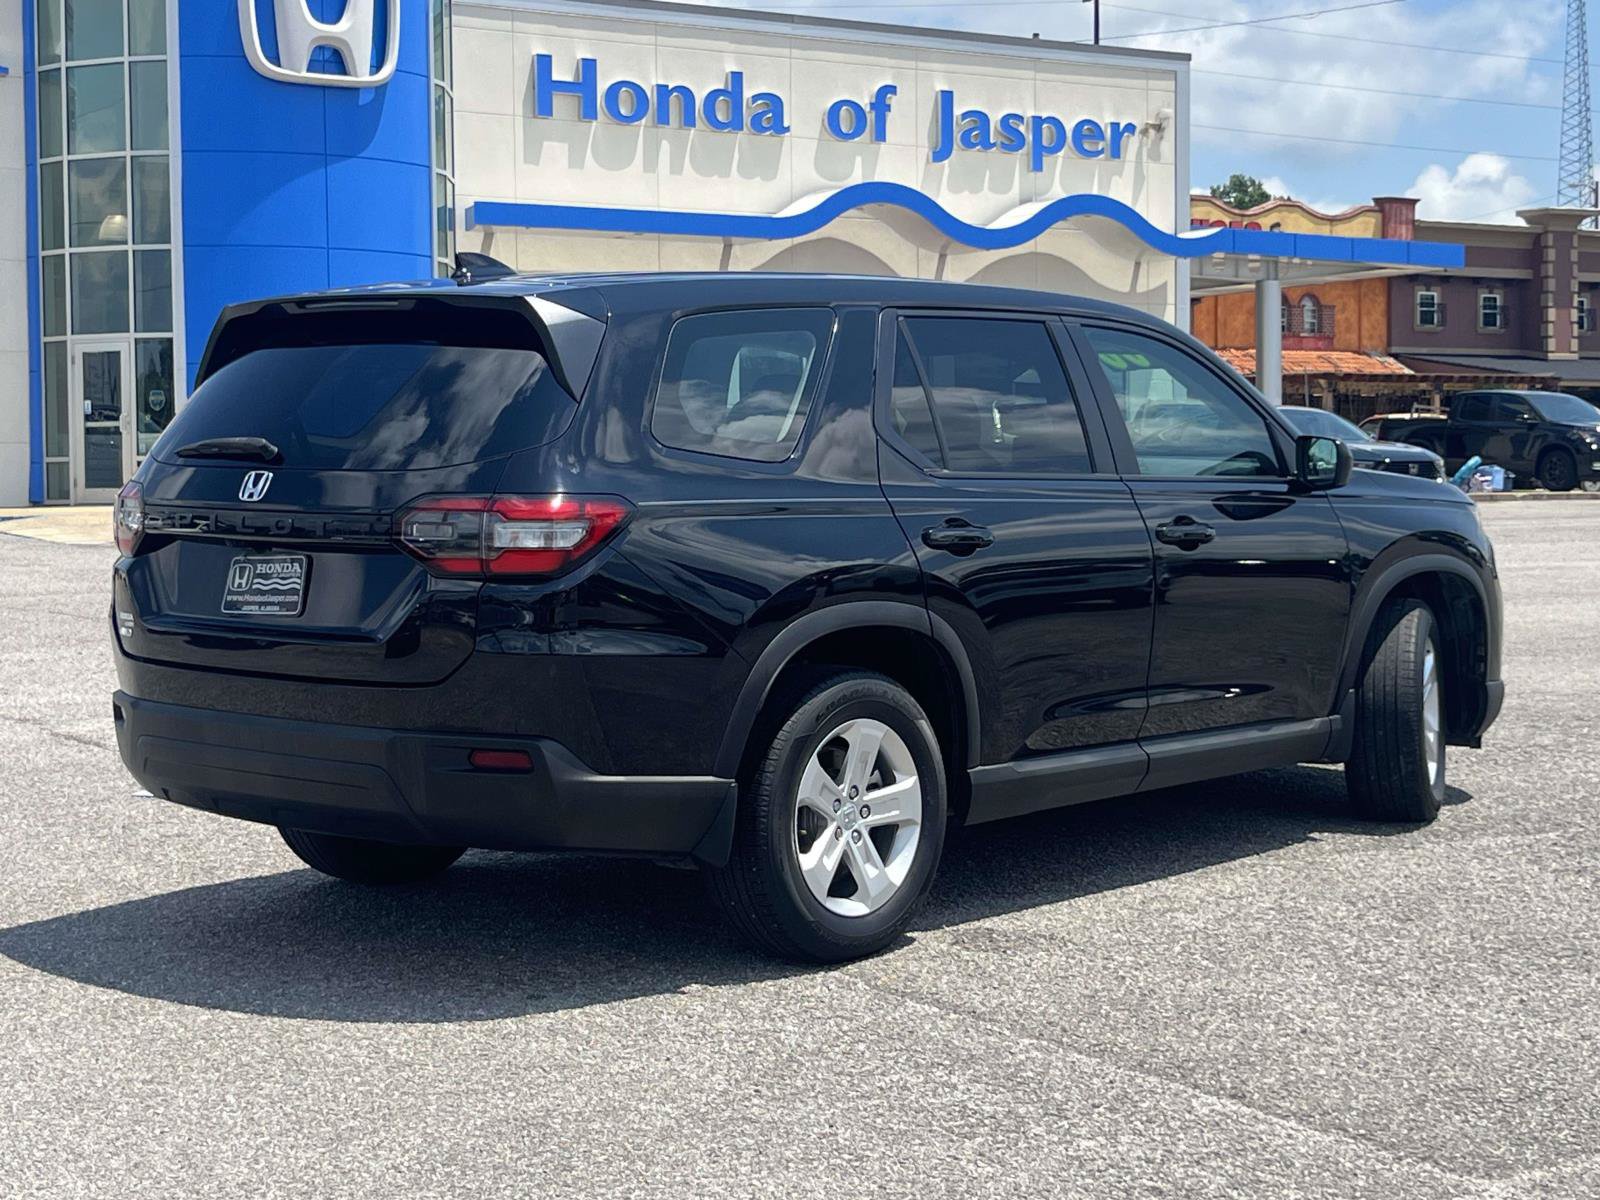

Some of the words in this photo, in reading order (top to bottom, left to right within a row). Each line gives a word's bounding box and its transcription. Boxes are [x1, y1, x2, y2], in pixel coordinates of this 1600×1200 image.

[534, 53, 791, 136] Honda
[825, 84, 897, 144] of
[931, 89, 1137, 173] Jasper
[256, 562, 302, 574] HONDA
